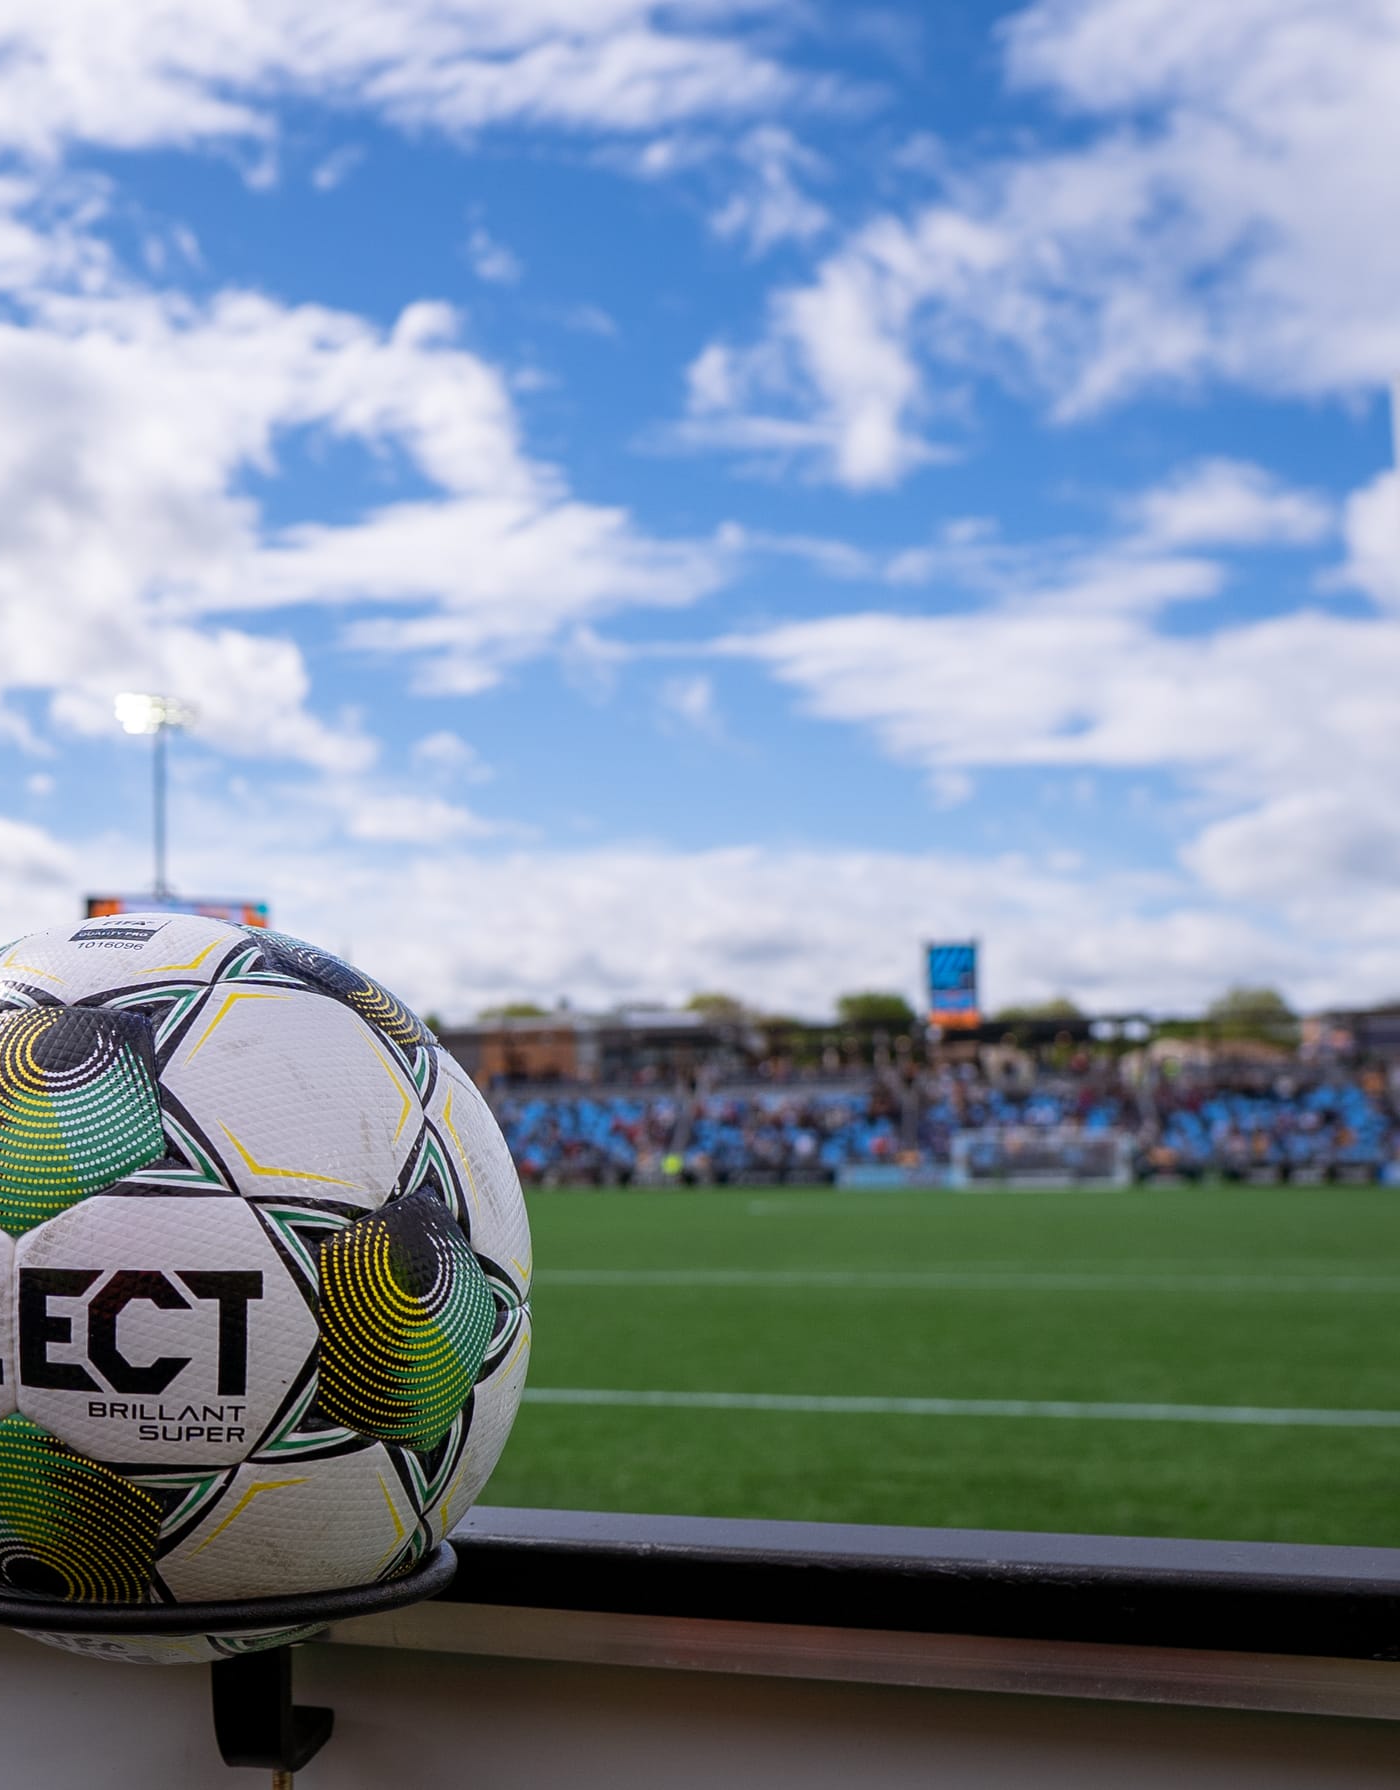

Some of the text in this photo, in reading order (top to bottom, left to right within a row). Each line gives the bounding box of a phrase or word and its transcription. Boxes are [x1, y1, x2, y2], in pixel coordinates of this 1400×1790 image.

[78, 930, 124, 938] QUALITY
[77, 941, 145, 951] 1016096
[88, 1401, 247, 1422] BRILLANT
[138, 1424, 246, 1443] SUPER
